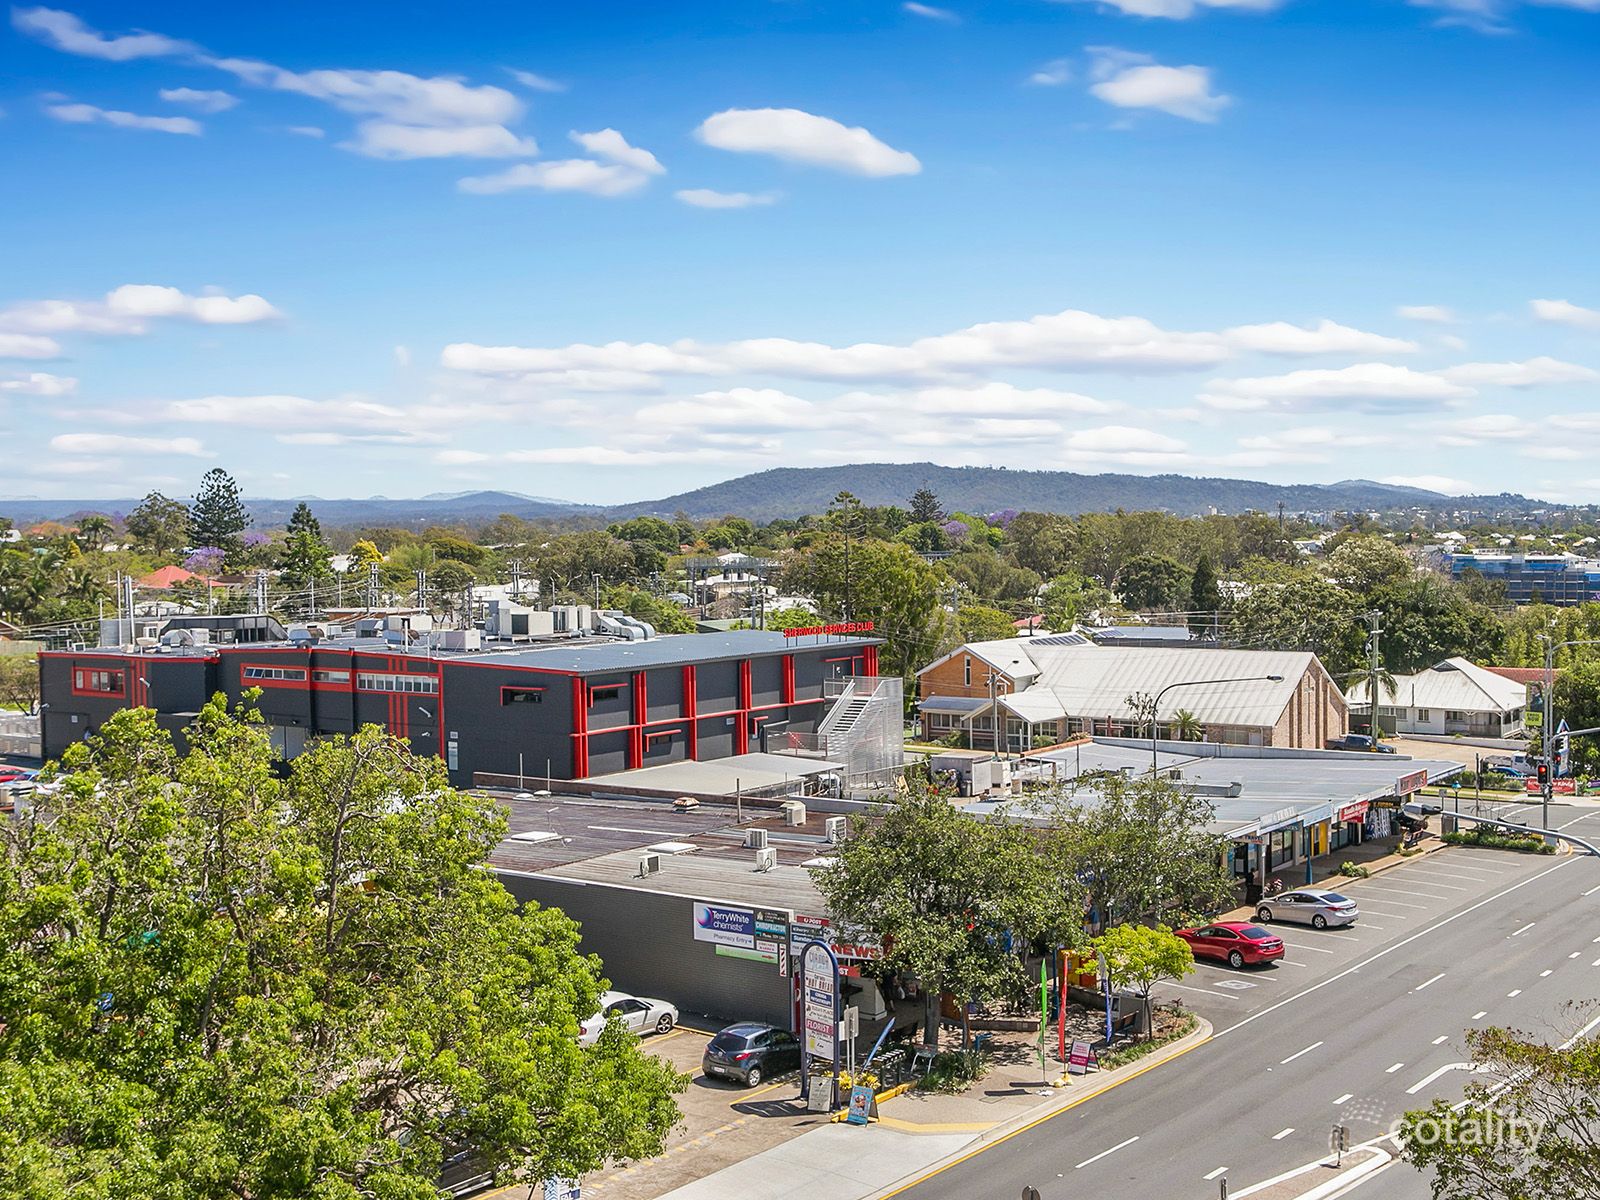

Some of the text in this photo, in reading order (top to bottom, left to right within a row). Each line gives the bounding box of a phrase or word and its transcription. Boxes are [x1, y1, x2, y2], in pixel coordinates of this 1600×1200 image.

[783, 621, 874, 638] SHERWOOD SERVICES CLUB
[712, 910, 750, 924] TerryWhite
[713, 920, 743, 932] chemists
[713, 933, 748, 945] Pharmacy Entry
[831, 944, 882, 958] NEWS
[807, 1021, 830, 1032] FLORIST
